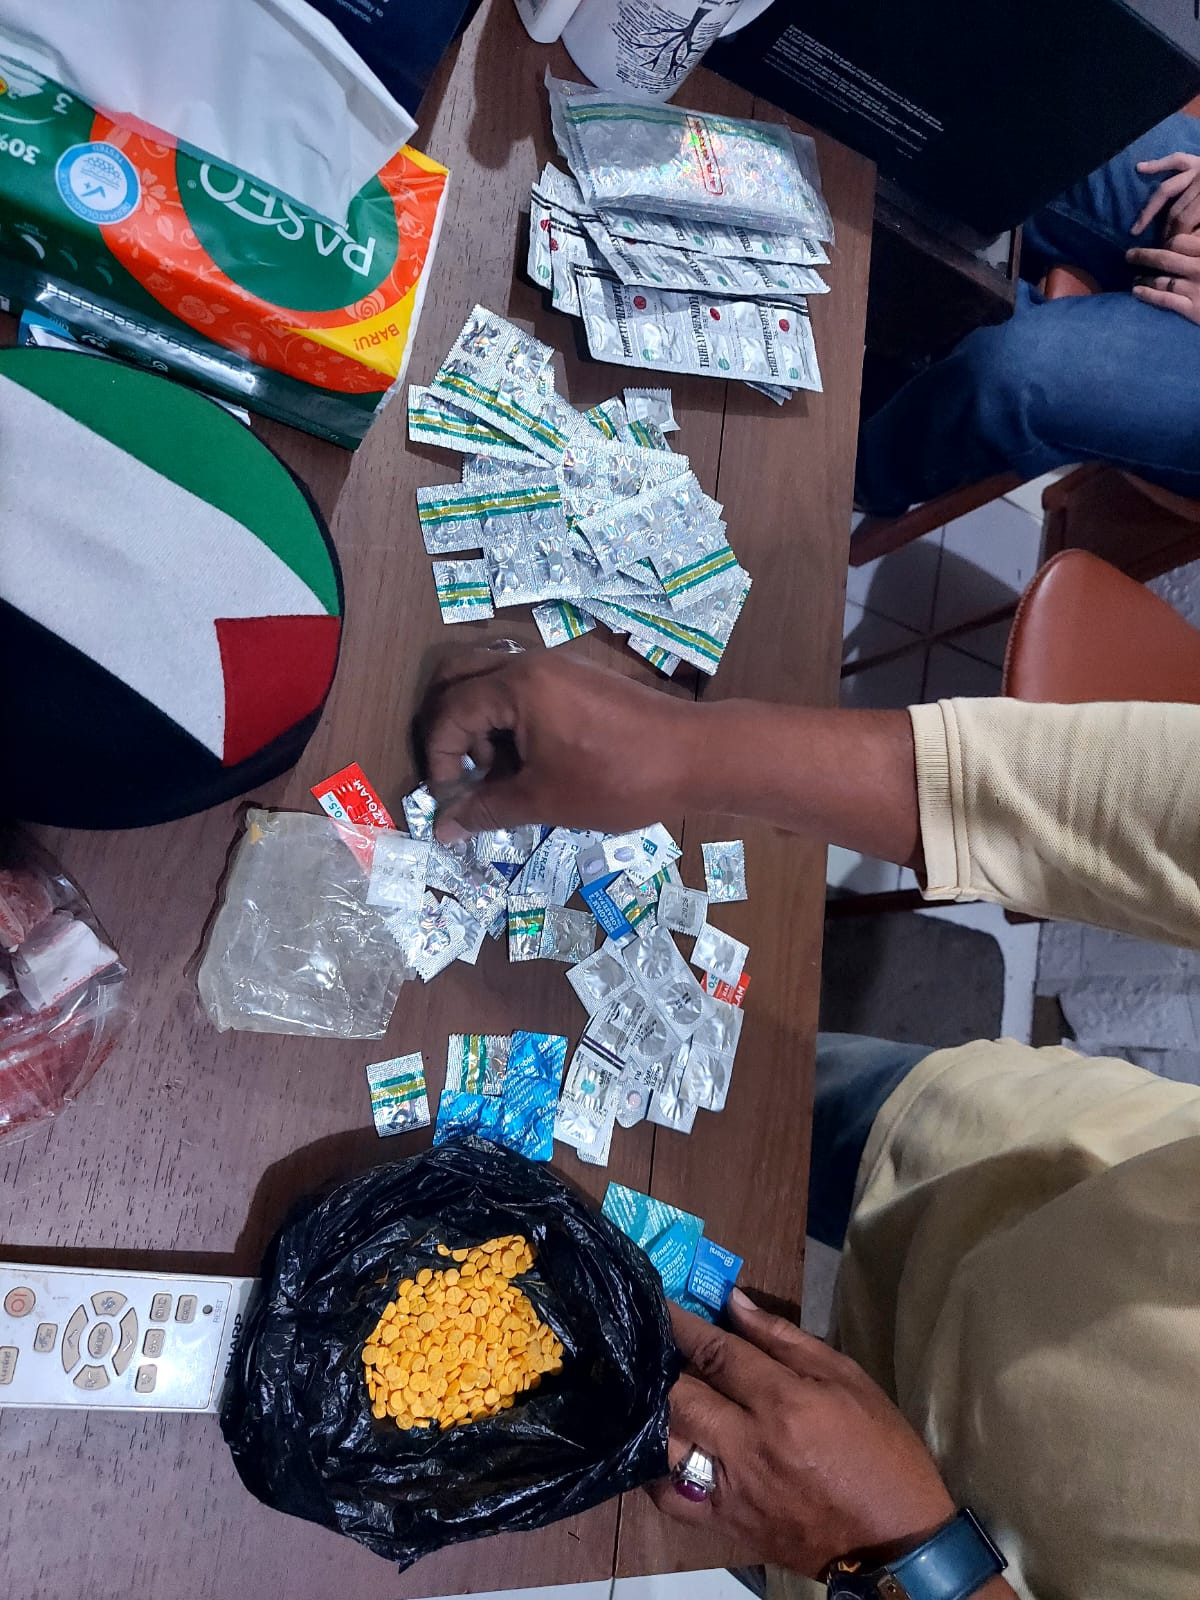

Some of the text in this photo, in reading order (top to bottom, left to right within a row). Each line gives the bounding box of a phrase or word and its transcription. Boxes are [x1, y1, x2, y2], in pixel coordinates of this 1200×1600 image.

[200, 163, 376, 277] PASEO
[354, 323, 400, 351] BARU!
[329, 802, 343, 818] 0,5
[538, 838, 553, 879] ZYPRAZ
[224, 1313, 243, 1378] SHARP
